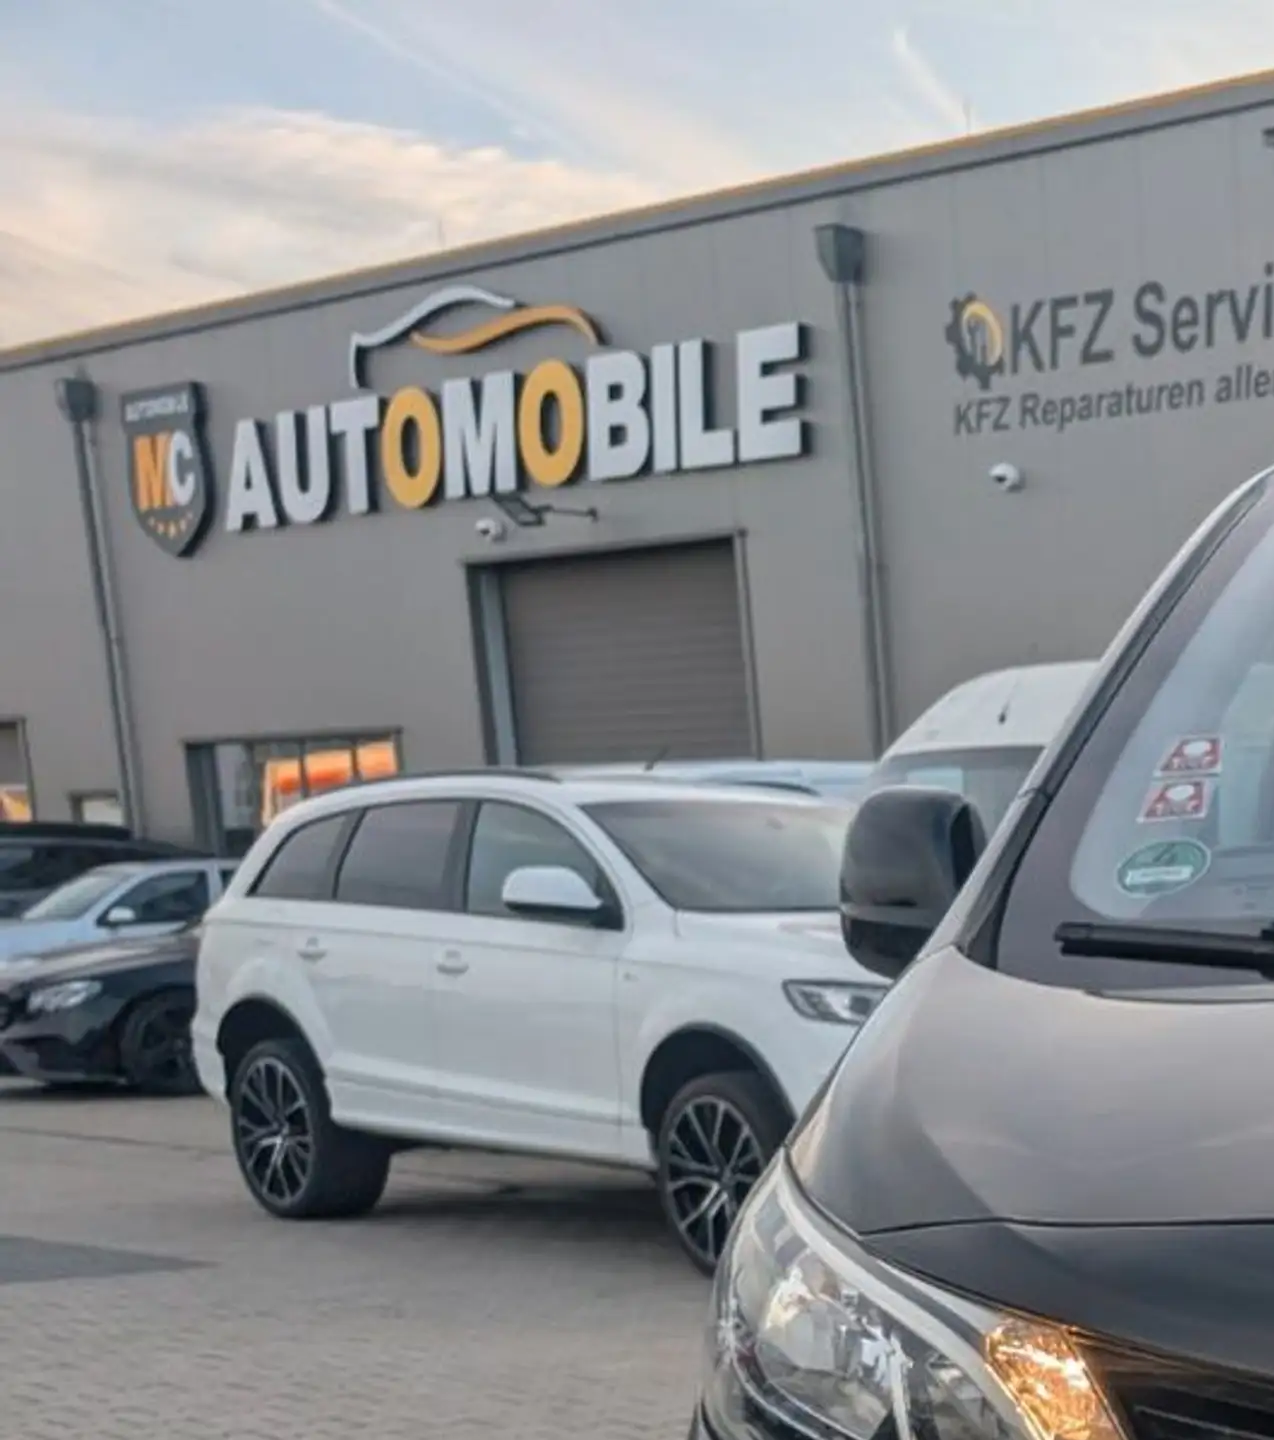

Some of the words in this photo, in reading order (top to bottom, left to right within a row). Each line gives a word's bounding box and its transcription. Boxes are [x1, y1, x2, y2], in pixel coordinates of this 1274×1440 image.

[1010, 288, 1115, 376] KFZ
[226, 322, 802, 531] AUTOMOBILE
[953, 396, 1011, 436] KFZ
[1019, 378, 1206, 432] Reparaturen
[133, 429, 196, 515] MC
